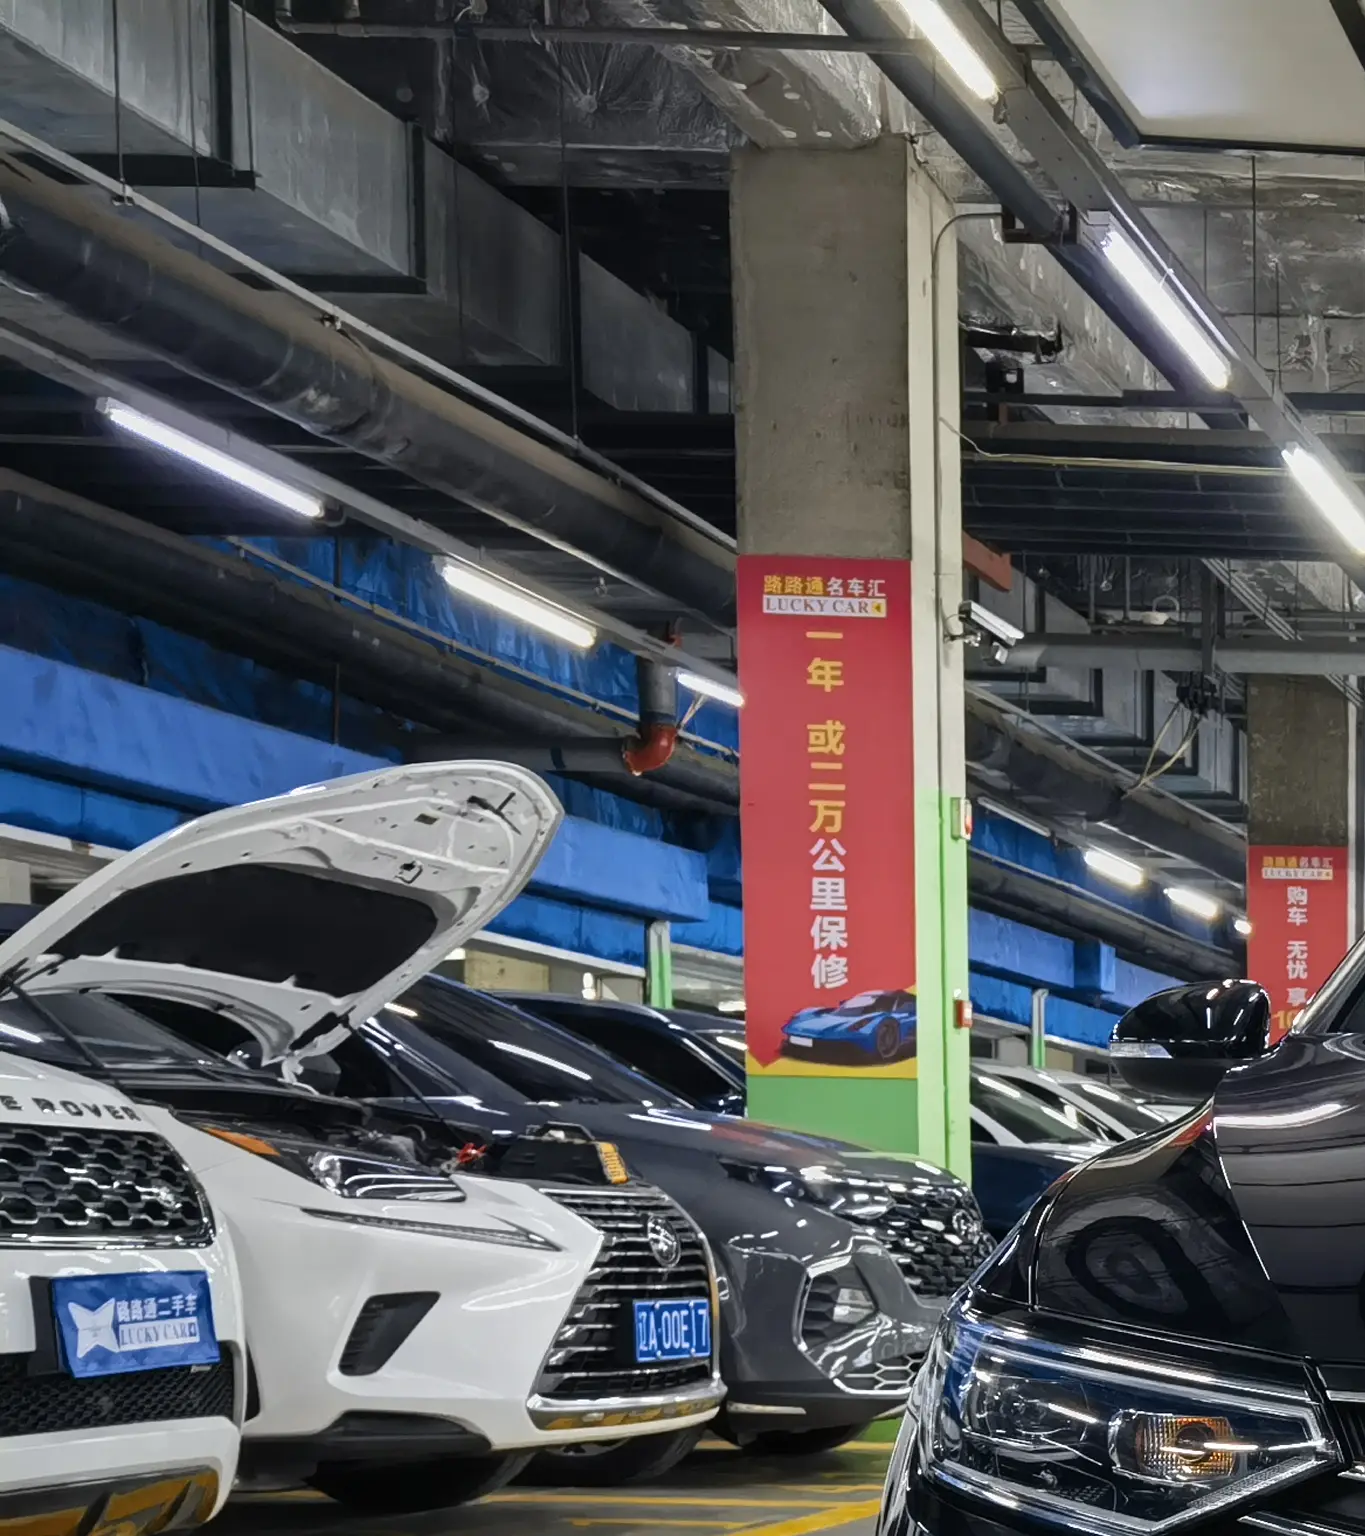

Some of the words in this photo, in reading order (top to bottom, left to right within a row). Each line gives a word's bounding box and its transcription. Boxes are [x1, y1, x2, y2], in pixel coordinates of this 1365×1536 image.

[763, 575, 886, 597] 路路通名车汇
[766, 598, 828, 612] LUCKY
[833, 599, 869, 614] CAR
[31, 1097, 141, 1121] ROVER
[120, 1325, 160, 1346] LUCKY
